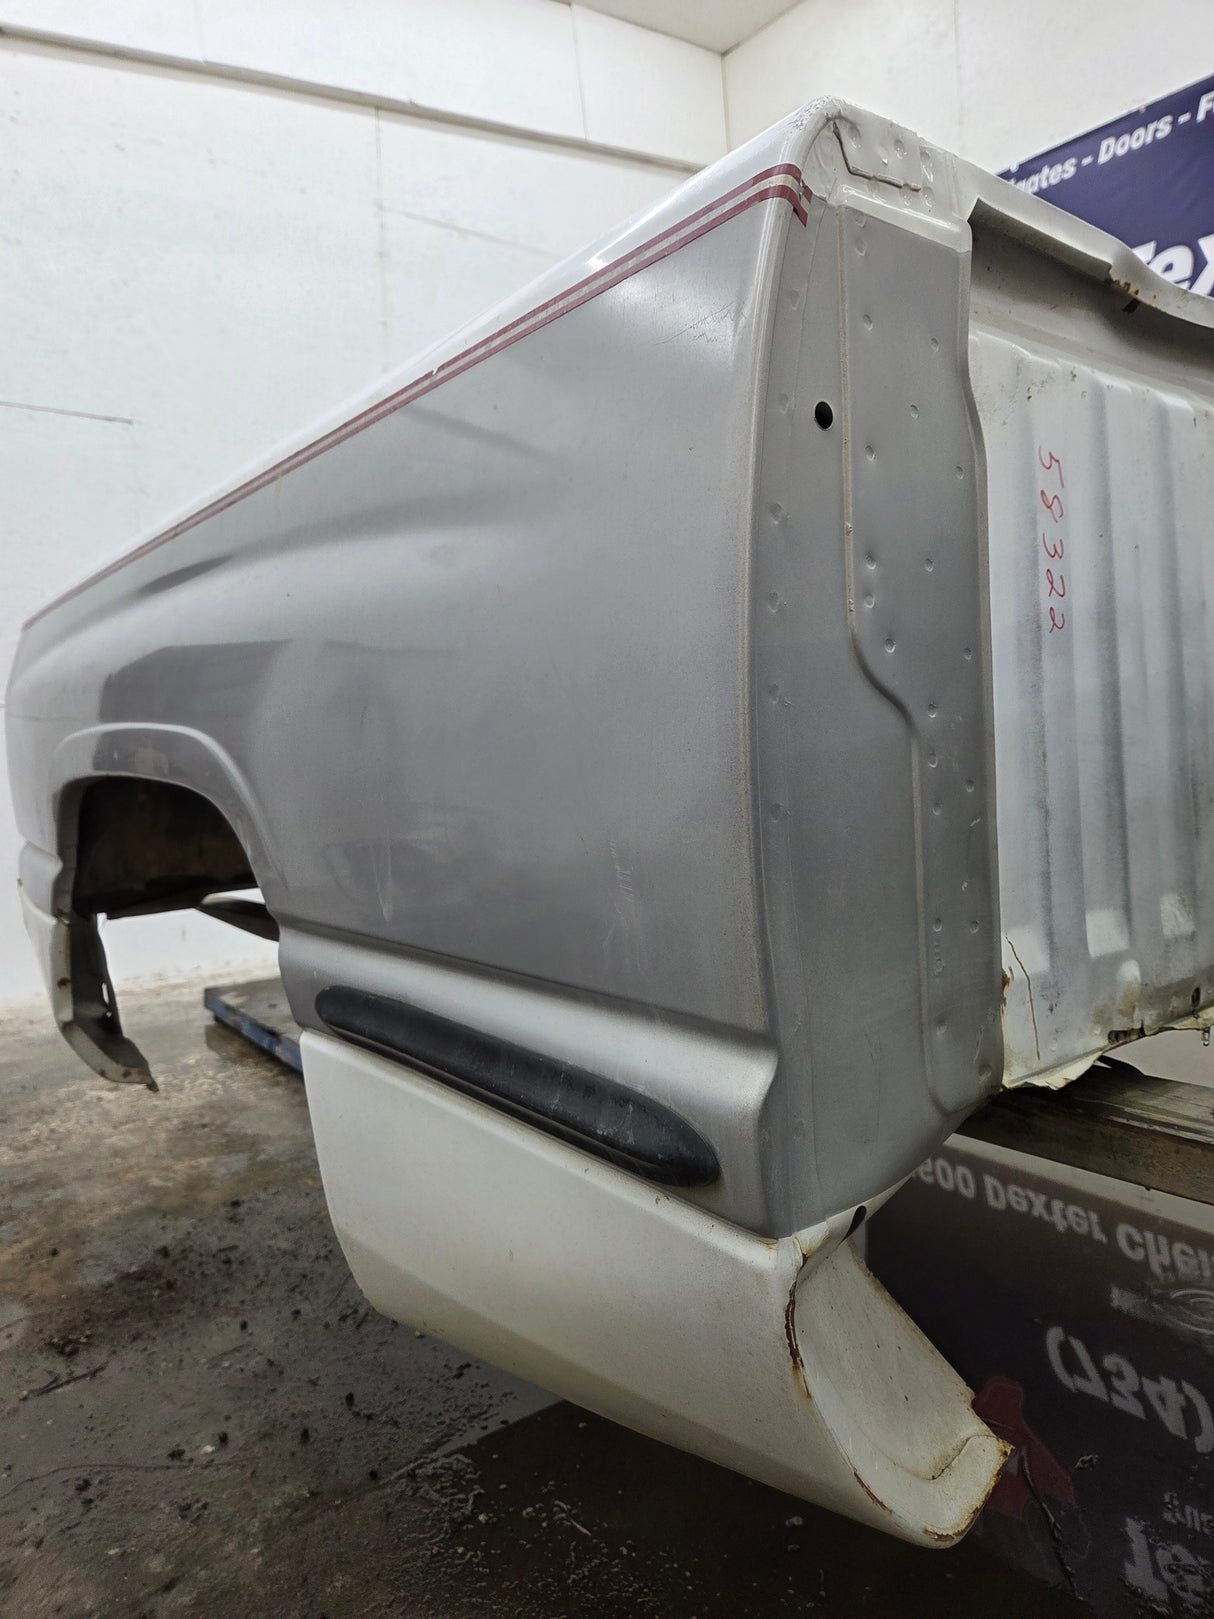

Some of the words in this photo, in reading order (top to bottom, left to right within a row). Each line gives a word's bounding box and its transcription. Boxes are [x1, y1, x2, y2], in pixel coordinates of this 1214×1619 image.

[1097, 113, 1174, 166] Doors
[1196, 90, 1214, 122] F
[1038, 443, 1066, 634] 58322
